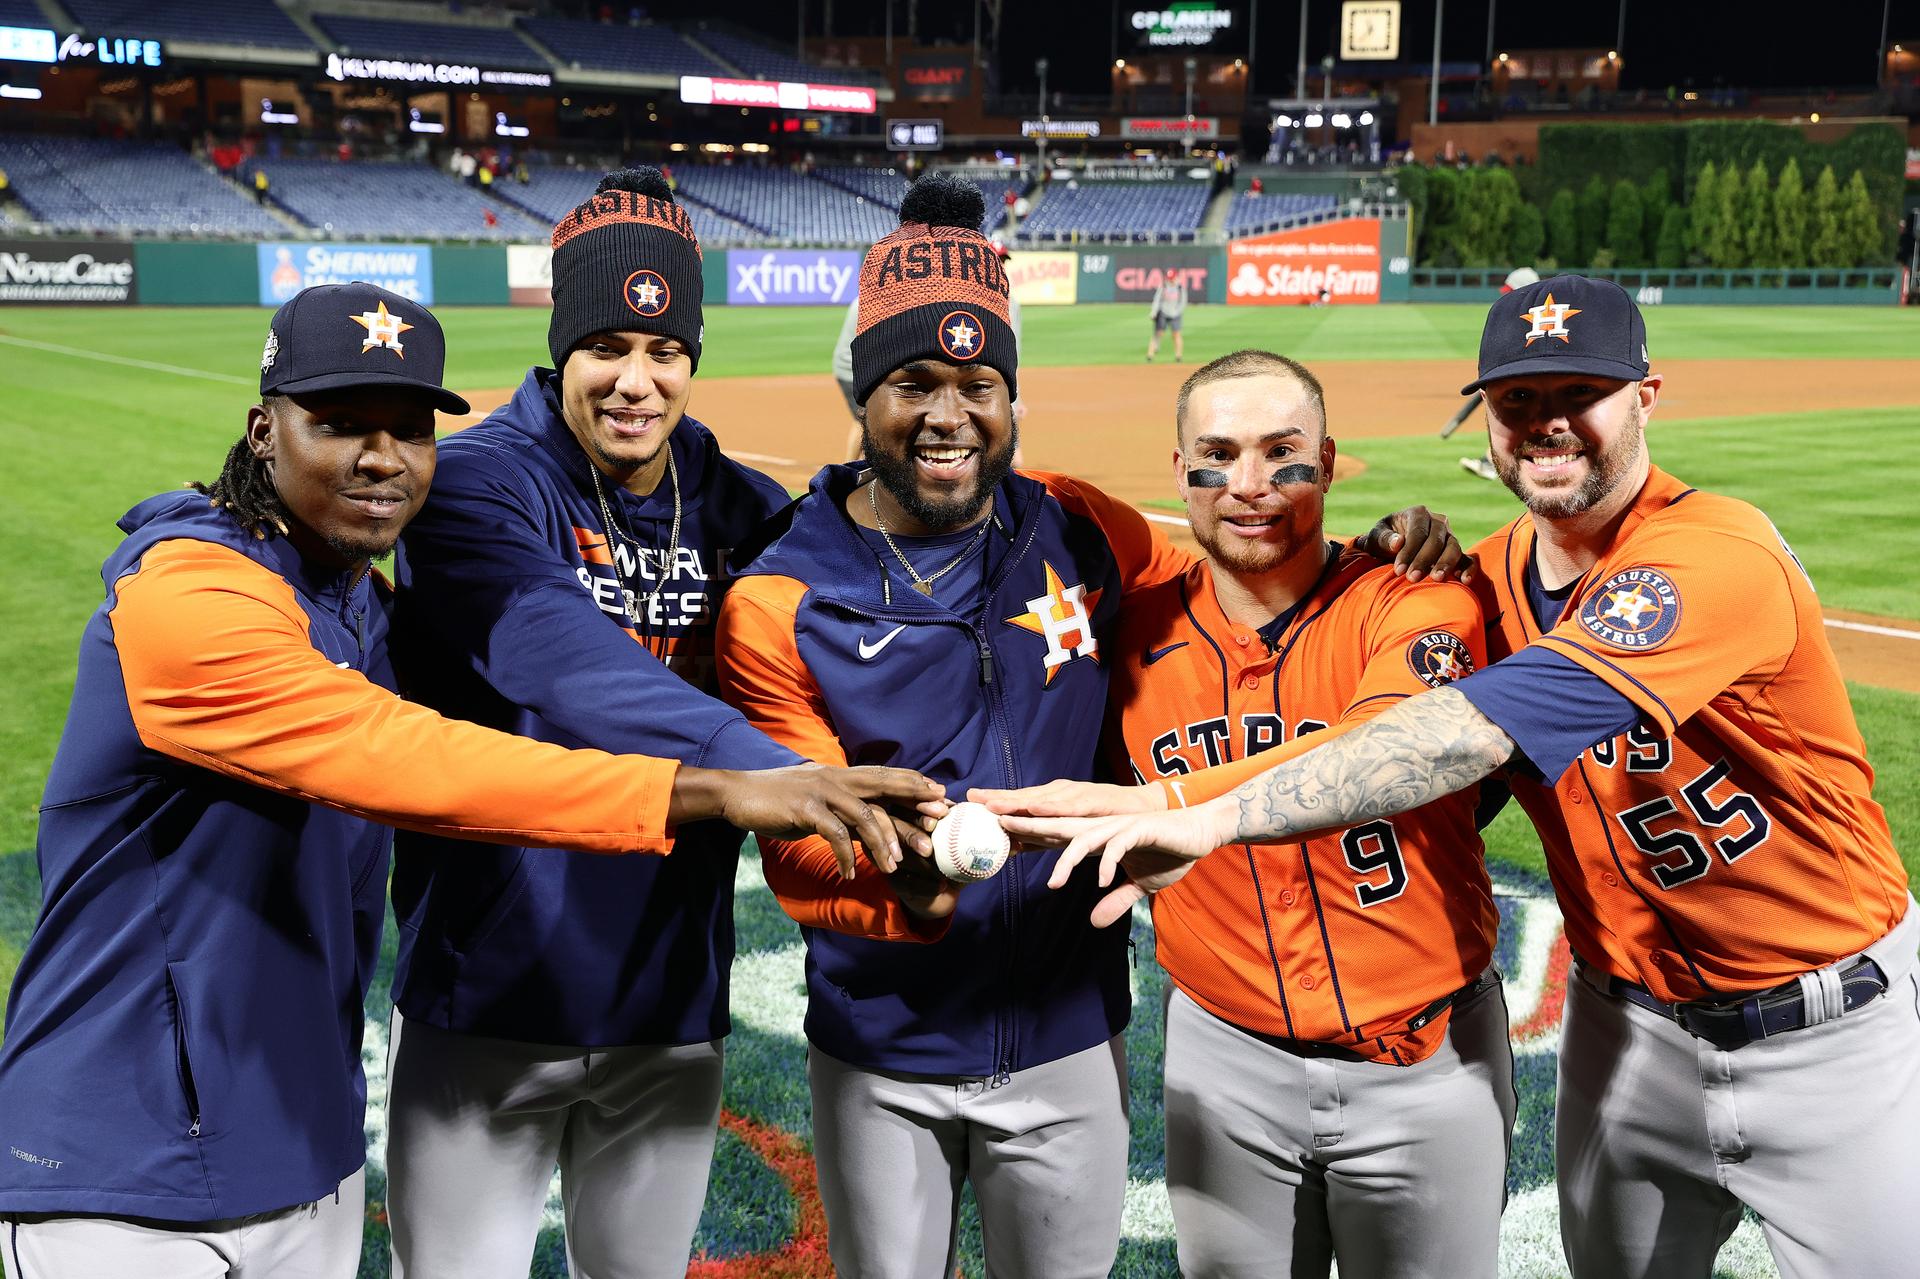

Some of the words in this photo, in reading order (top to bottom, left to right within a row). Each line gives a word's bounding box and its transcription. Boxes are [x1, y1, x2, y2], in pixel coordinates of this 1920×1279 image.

[98, 37, 162, 67] LIFE
[736, 253, 852, 303] xfinity
[576, 566, 711, 626] SERES
[1605, 571, 1677, 605] HOUSTON
[1583, 615, 1649, 645] ASTROS
[1420, 634, 1475, 673] HOUSTON
[1615, 755, 1772, 891] 55
[1339, 818, 1409, 909] 9
[10, 1145, 64, 1169] THERMA-FIT
